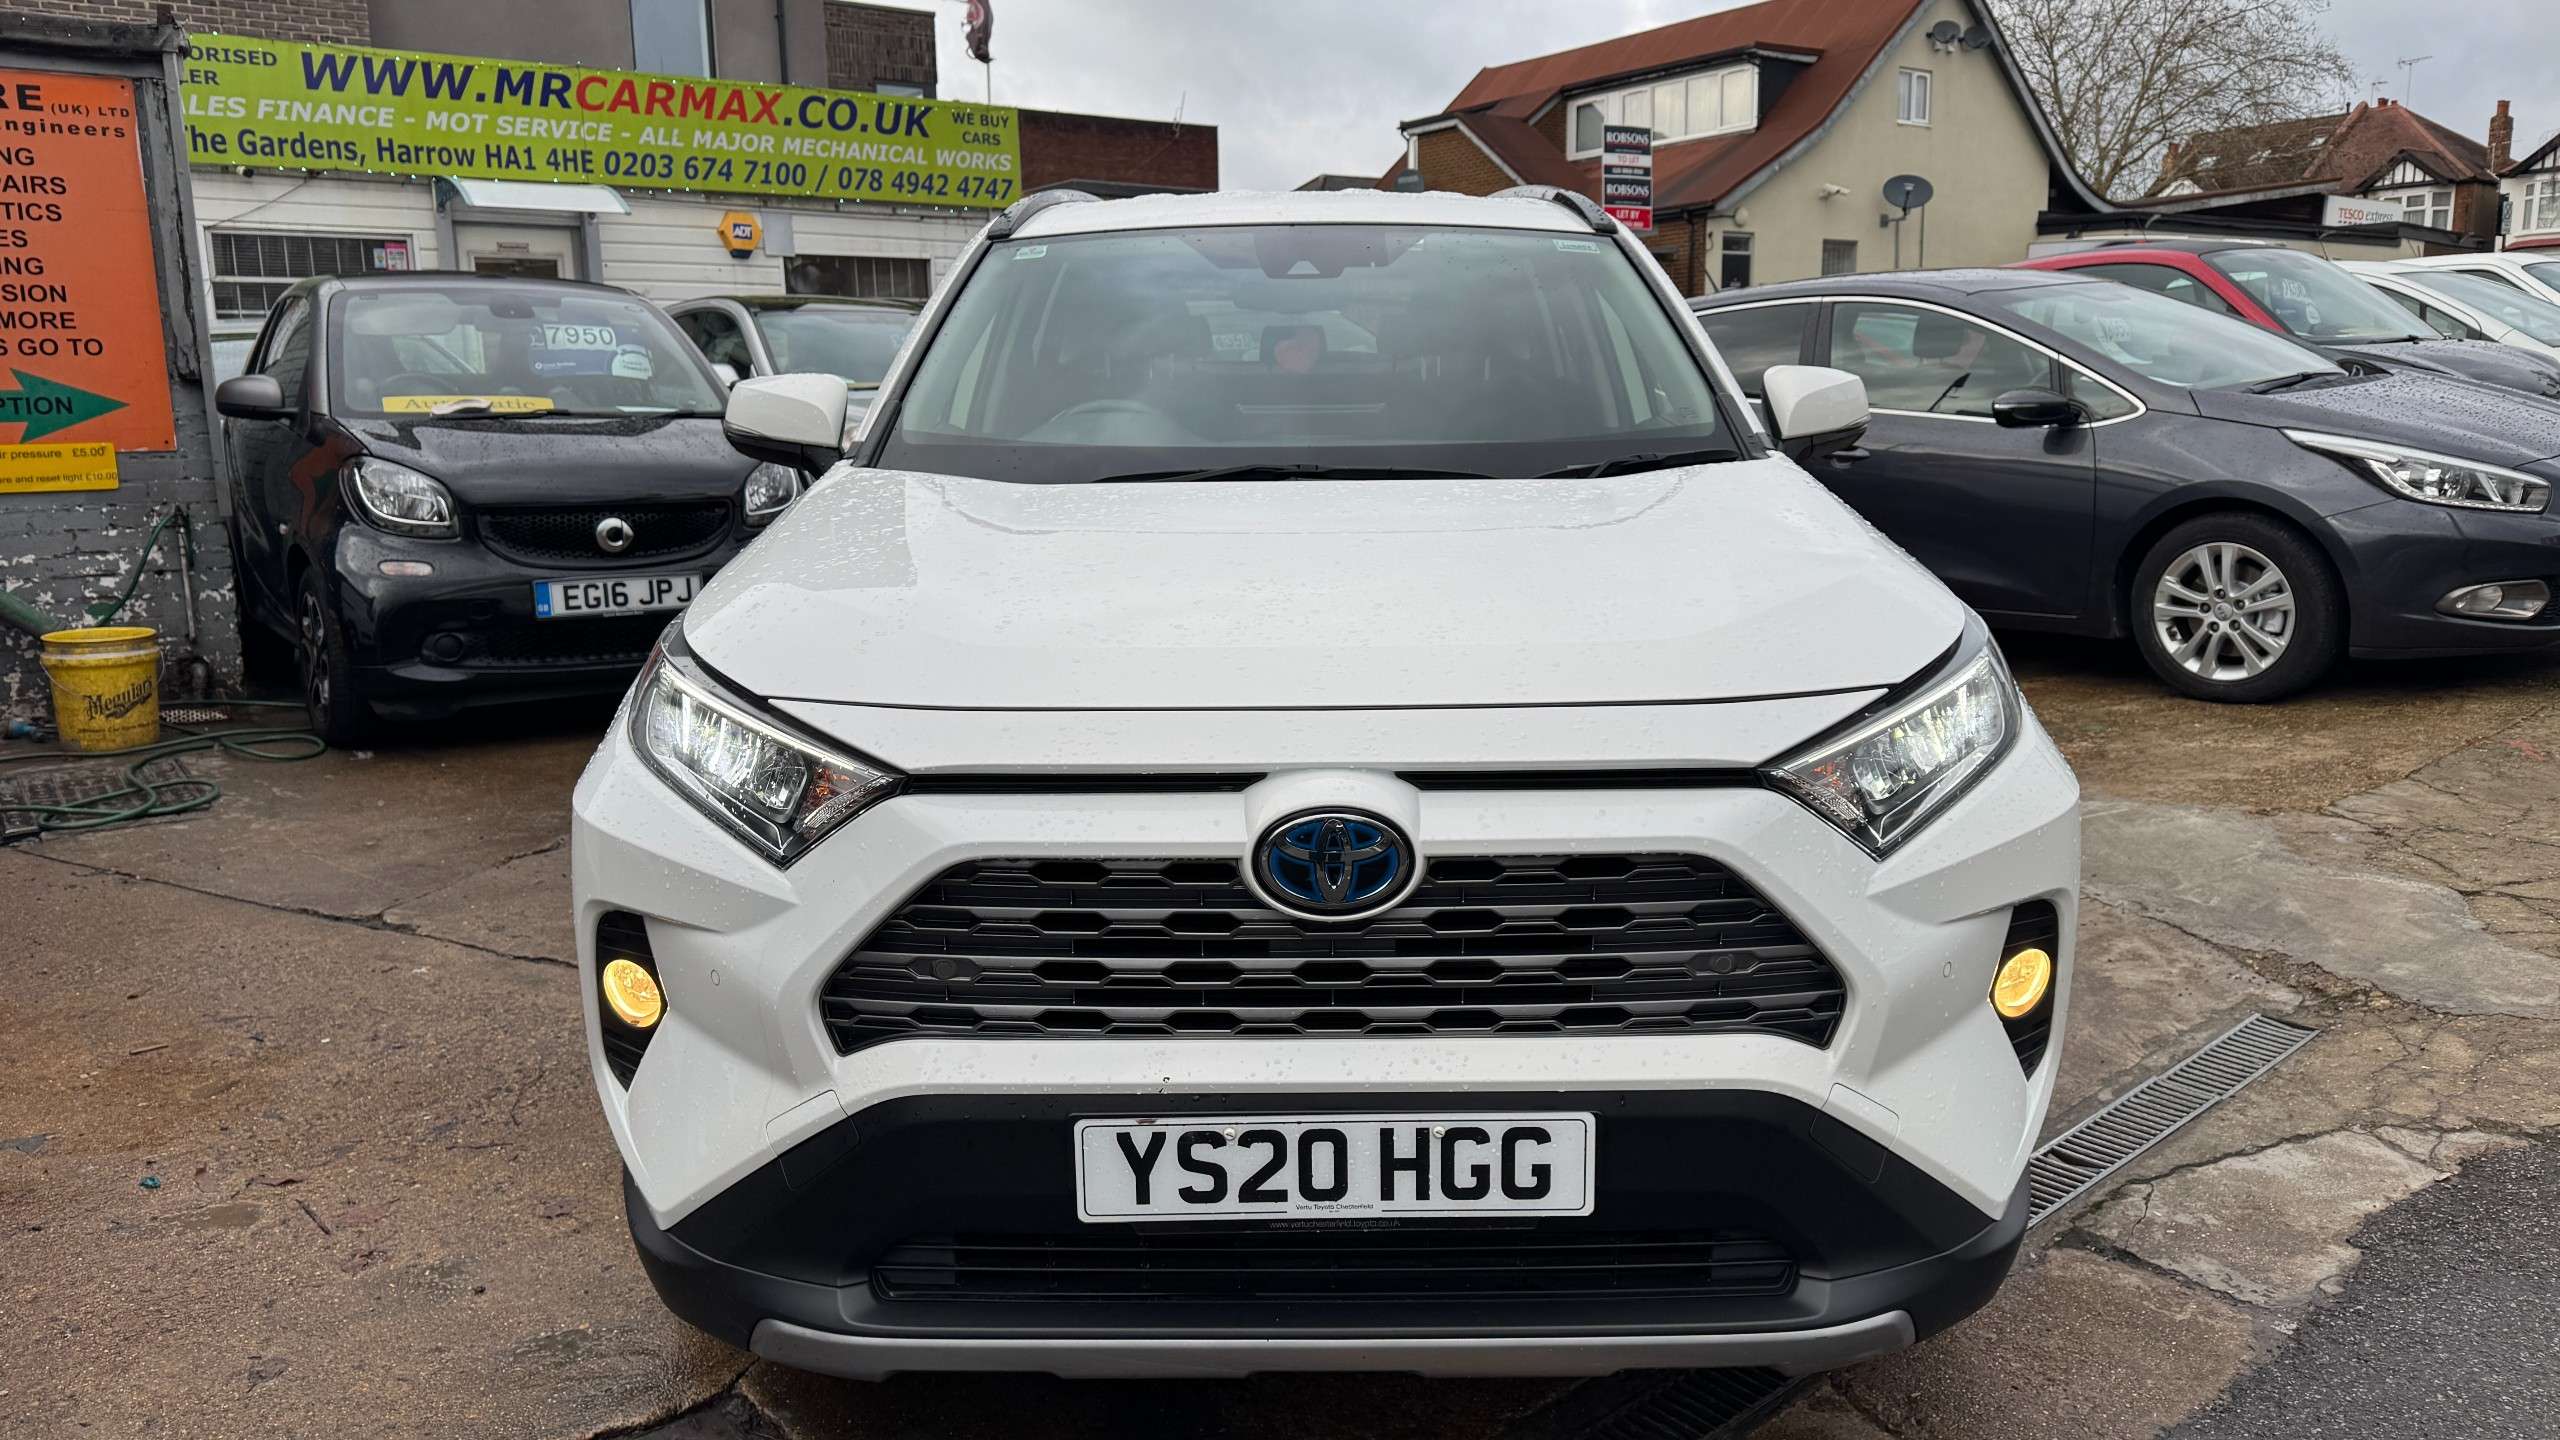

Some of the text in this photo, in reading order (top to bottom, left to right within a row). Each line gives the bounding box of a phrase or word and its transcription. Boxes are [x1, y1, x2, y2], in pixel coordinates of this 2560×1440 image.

[301, 51, 930, 138] WWW.MRCARMAX.CO.UK
[51, 103, 90, 117] (UK)
[98, 107, 130, 118] LTD
[0, 119, 126, 138] ngineers
[952, 112, 1009, 128] WE BUY
[183, 94, 246, 119] LES
[257, 98, 395, 128] FINANCE
[426, 111, 488, 133] MOT
[496, 115, 613, 142] SERVICE
[639, 126, 684, 147] ALL
[692, 130, 775, 154] MAJOR
[782, 137, 928, 165] MECHANICAL
[935, 149, 1012, 172] WORKS
[962, 131, 1001, 146] CARS
[1606, 132, 1650, 144] ROBSONS
[184, 124, 228, 154] he
[237, 128, 366, 166] Gardens,
[376, 137, 475, 167] Harrow
[485, 144, 536, 170] HA1
[546, 148, 594, 174] 4HE
[604, 150, 673, 179] 0203
[684, 156, 733, 182] 674
[744, 160, 806, 186] 7100
[838, 166, 883, 192] 078
[891, 170, 949, 196] 4942
[957, 176, 1014, 200] 4747
[0, 175, 67, 195] AIRS
[1606, 184, 1650, 197] ROBSONS
[0, 202, 63, 222] TICS
[2338, 207, 2364, 221] TESCO
[734, 225, 752, 238] ADT
[0, 311, 77, 329] MORE
[18, 338, 59, 356] GO
[66, 338, 104, 356] TO
[11, 449, 63, 461] pressure
[563, 577, 693, 611] EG16 JPJ
[1116, 1126, 1553, 1206] YS20 HGG
